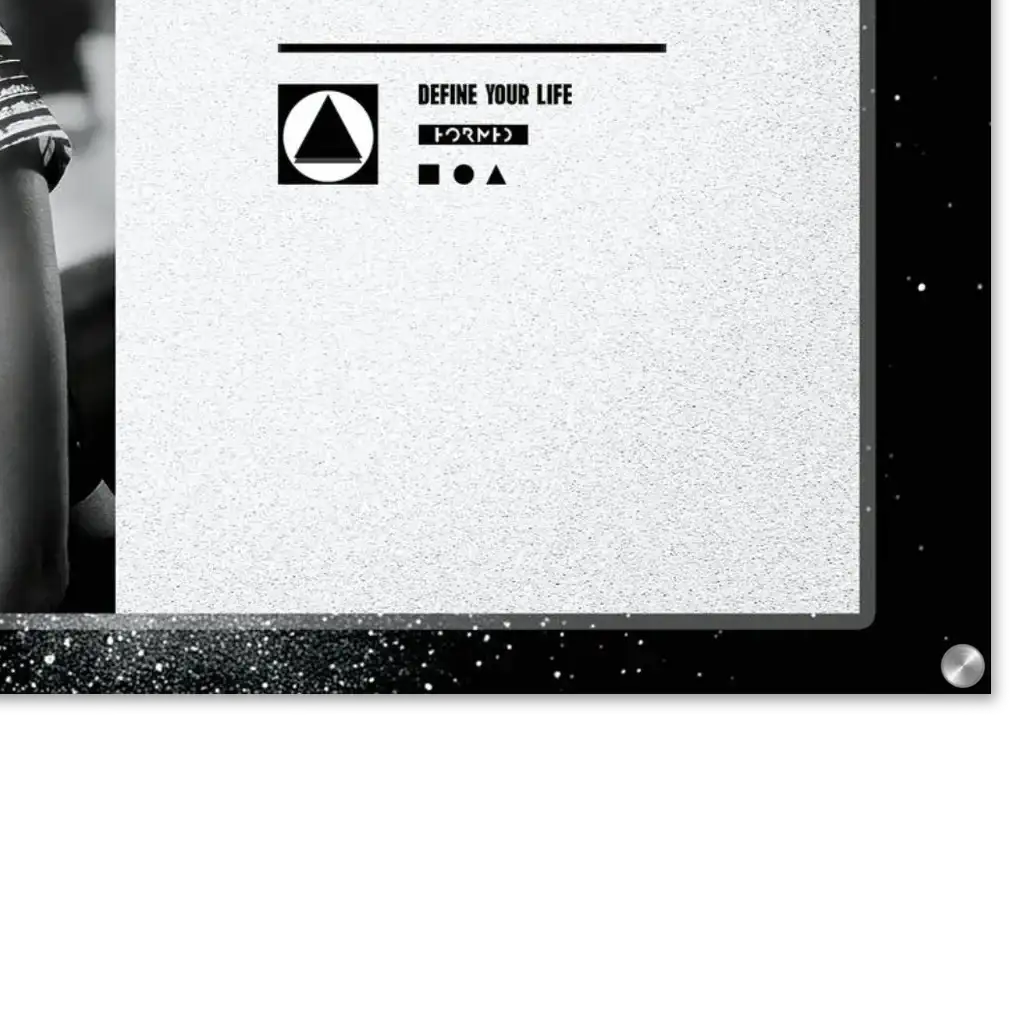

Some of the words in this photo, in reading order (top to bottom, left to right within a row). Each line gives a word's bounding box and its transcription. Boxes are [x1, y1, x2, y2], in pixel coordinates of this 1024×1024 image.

[418, 83, 478, 105] DEFINE
[485, 83, 530, 105] YOUR
[536, 83, 573, 105] LIFE
